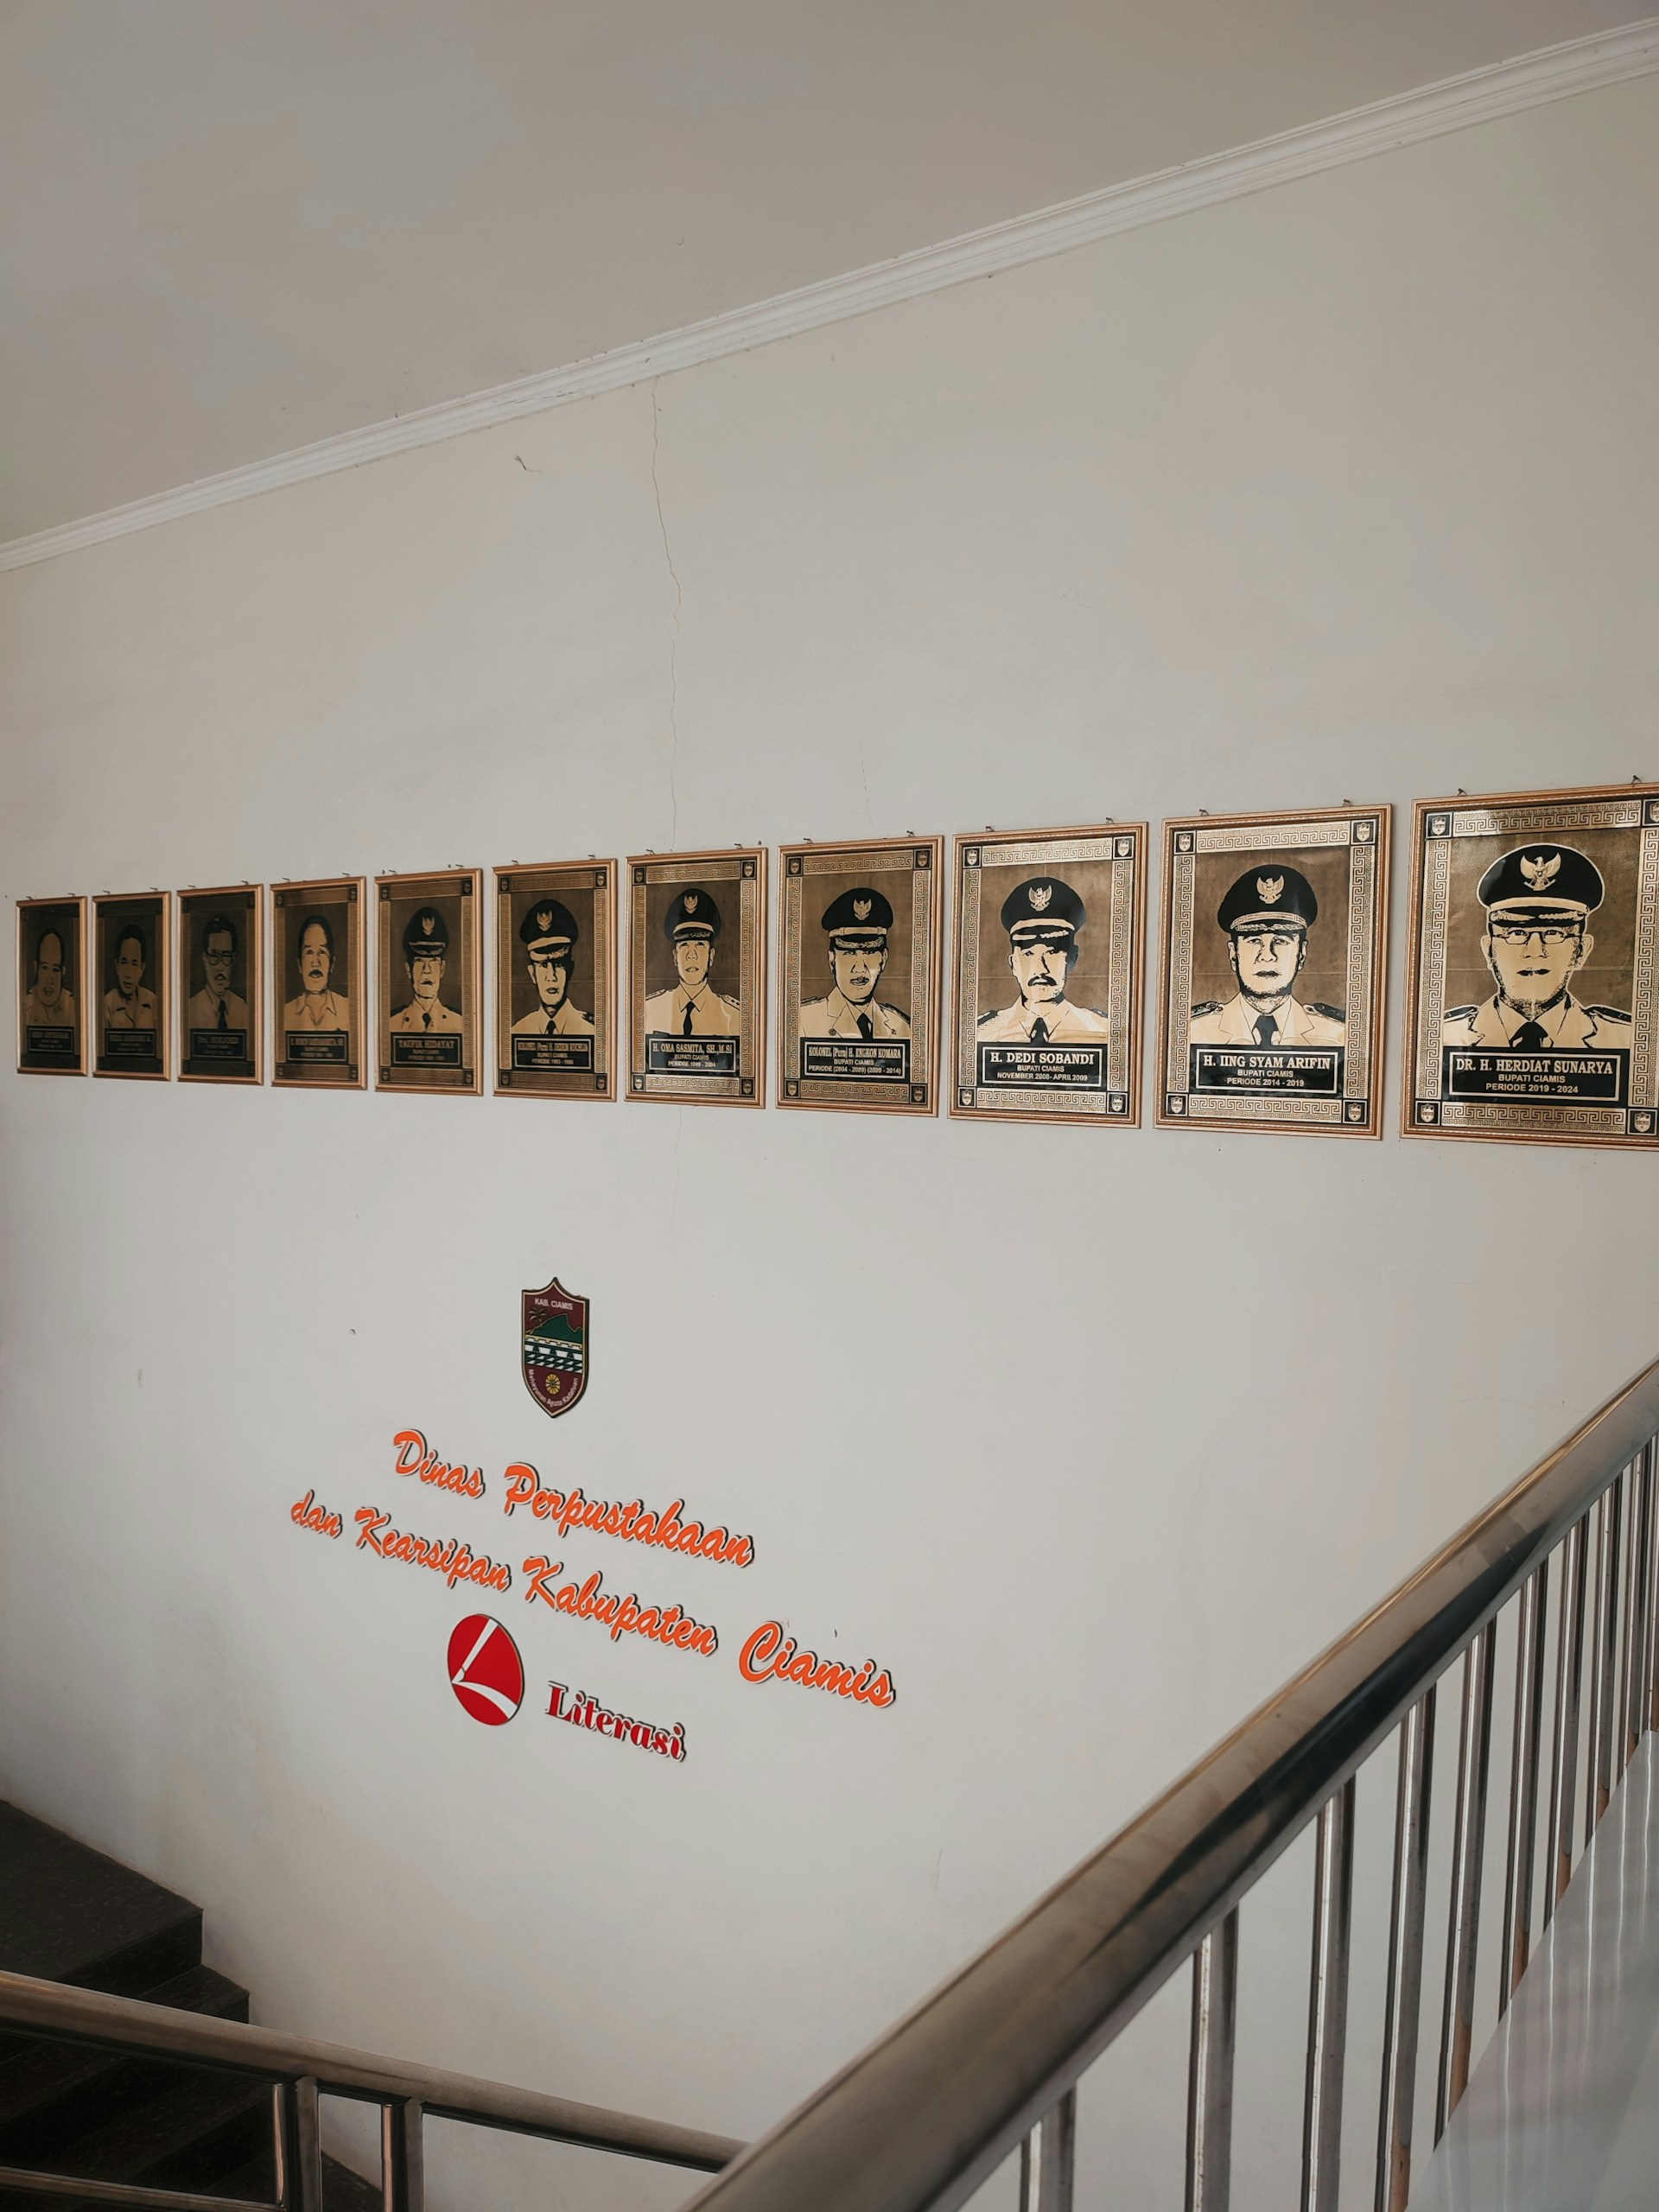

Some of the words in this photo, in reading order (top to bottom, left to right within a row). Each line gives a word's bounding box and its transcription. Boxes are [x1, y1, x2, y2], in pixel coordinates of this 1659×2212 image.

[652, 1043, 659, 1052] H.
[660, 1044, 674, 1052] OMA
[676, 1044, 705, 1054] SASMITA,
[849, 1048, 855, 1058] H.
[990, 1052, 1002, 1063] H.
[1006, 1052, 1035, 1063] DEDI
[1039, 1052, 1095, 1065] SOBANDI
[1203, 1055, 1217, 1066] H.
[1220, 1056, 1246, 1067] IING
[1249, 1056, 1283, 1068] SYAM
[1287, 1058, 1331, 1070] ARIFIN
[1455, 1058, 1476, 1071] DR.
[1479, 1058, 1492, 1071] H.
[1496, 1059, 1551, 1073] HERDIAT
[1554, 1060, 1613, 1075] SUNARYA
[1237, 1069, 1265, 1077] BUPATI
[1267, 1070, 1294, 1078] CIAMIS
[1498, 1074, 1531, 1083] BUPATI
[1533, 1075, 1566, 1084] CIAMIS
[1227, 1077, 1261, 1086] PERIODE
[1485, 1083, 1526, 1091] PERIODE
[534, 1298, 550, 1306] KAB.
[550, 1300, 573, 1310] CIAMIS
[393, 1430, 484, 1497] Dinas
[504, 1463, 753, 1567] Perpustakaan
[290, 1491, 340, 1537] dan
[355, 1507, 511, 1592] Kearsipan
[522, 1557, 716, 1656] Kabupaten
[739, 1621, 893, 1707] Ciamis
[546, 1682, 685, 1760] Literasi
